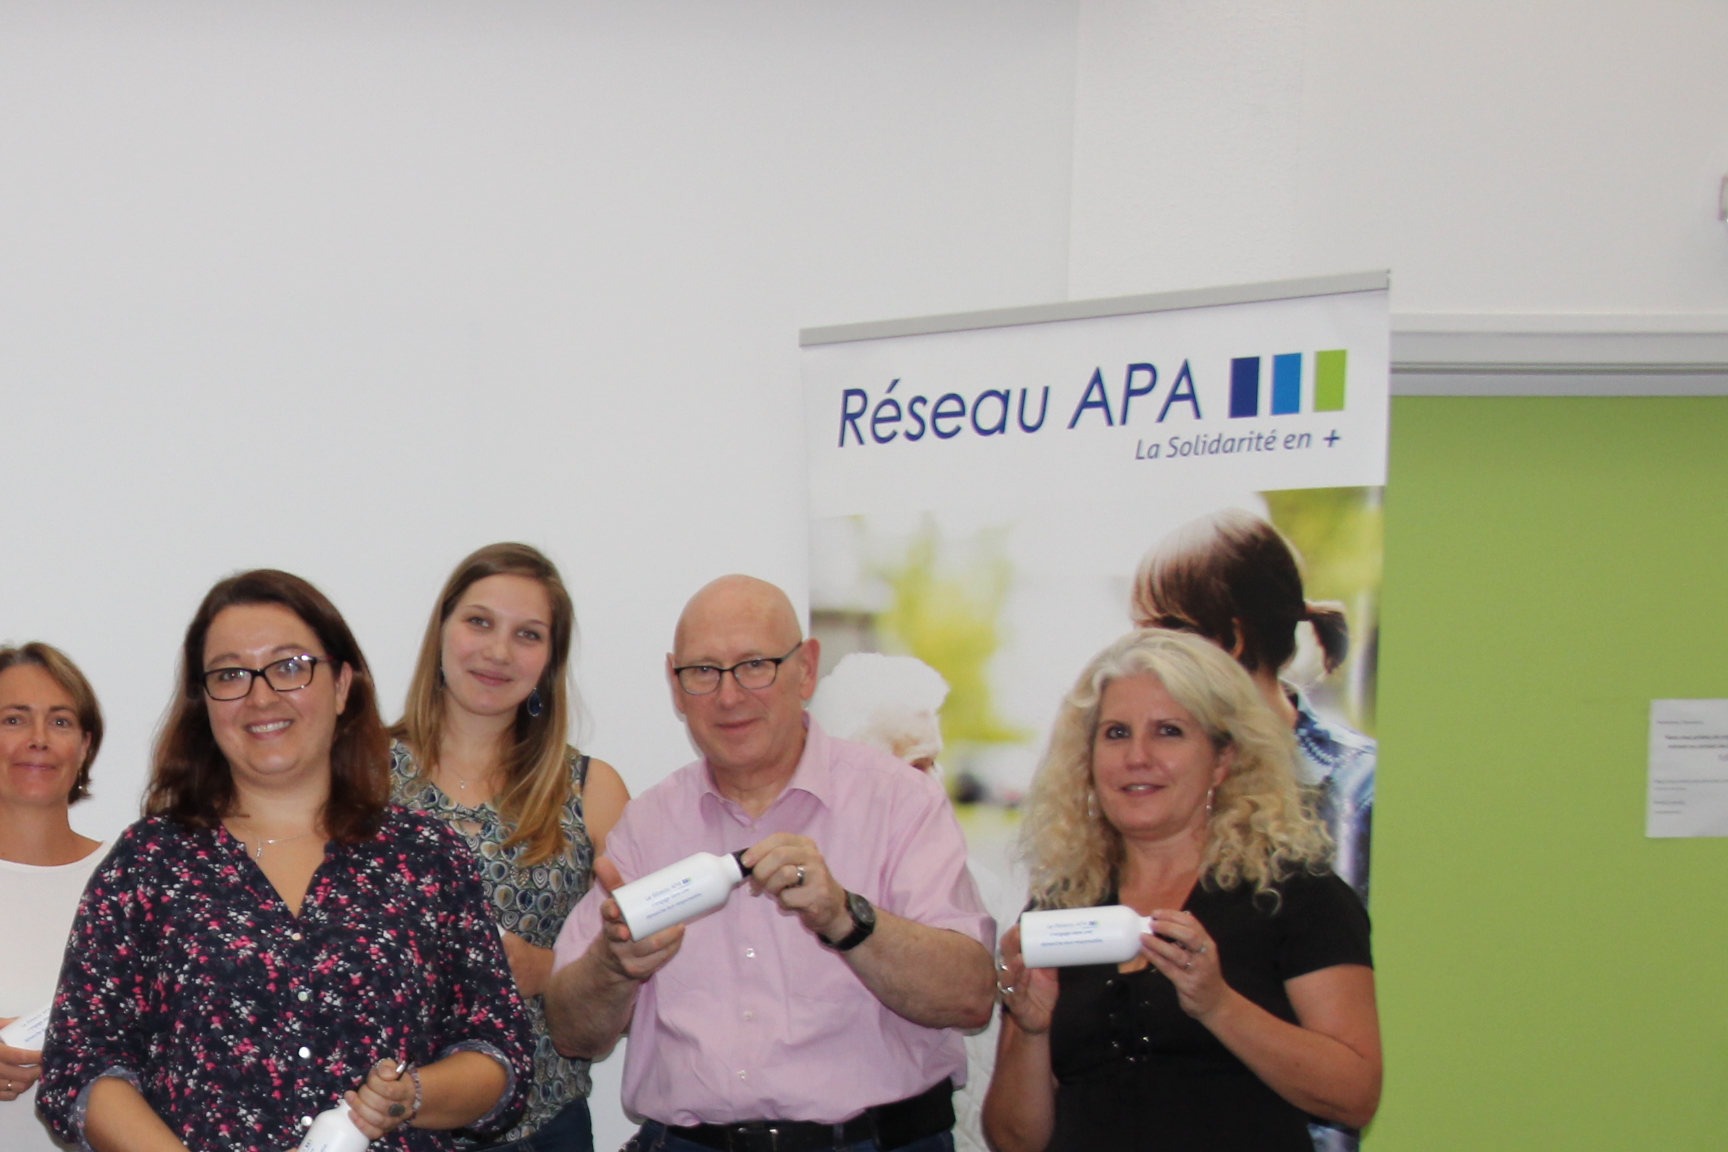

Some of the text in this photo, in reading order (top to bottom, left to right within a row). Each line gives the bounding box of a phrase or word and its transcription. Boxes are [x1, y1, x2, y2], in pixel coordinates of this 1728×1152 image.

[838, 359, 1202, 448] Réseau APA
[1135, 439, 1160, 460] La
[1165, 429, 1277, 458] Solidarité
[1283, 432, 1311, 449] en
